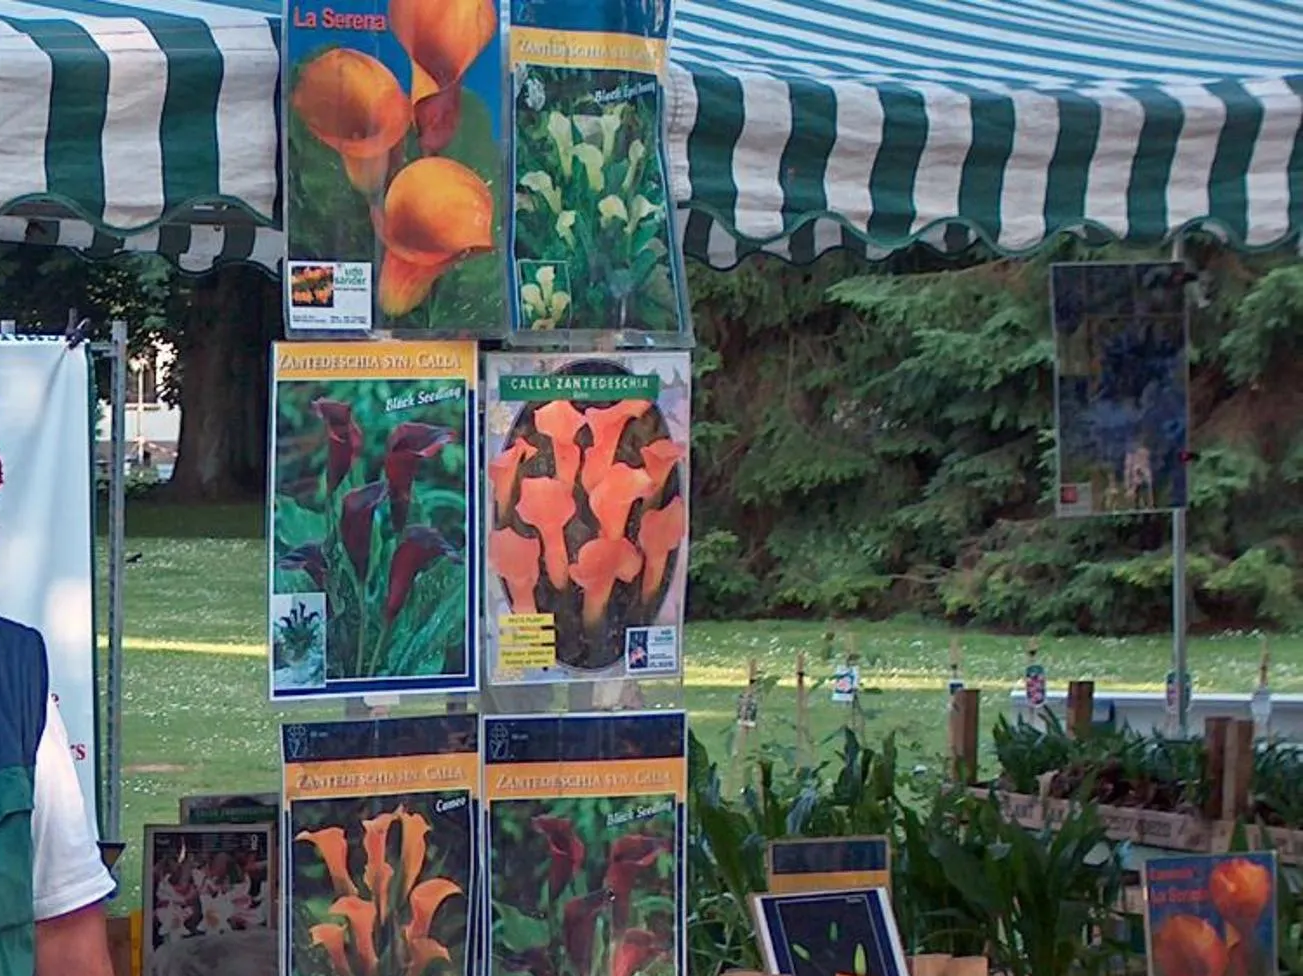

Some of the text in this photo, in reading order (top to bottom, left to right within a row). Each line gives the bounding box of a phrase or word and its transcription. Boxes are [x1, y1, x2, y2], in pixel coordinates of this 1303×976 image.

[294, 6, 386, 31] La Serena
[510, 377, 649, 390] CALLA ZANTEDESCHIA
[386, 397, 414, 411] Black
